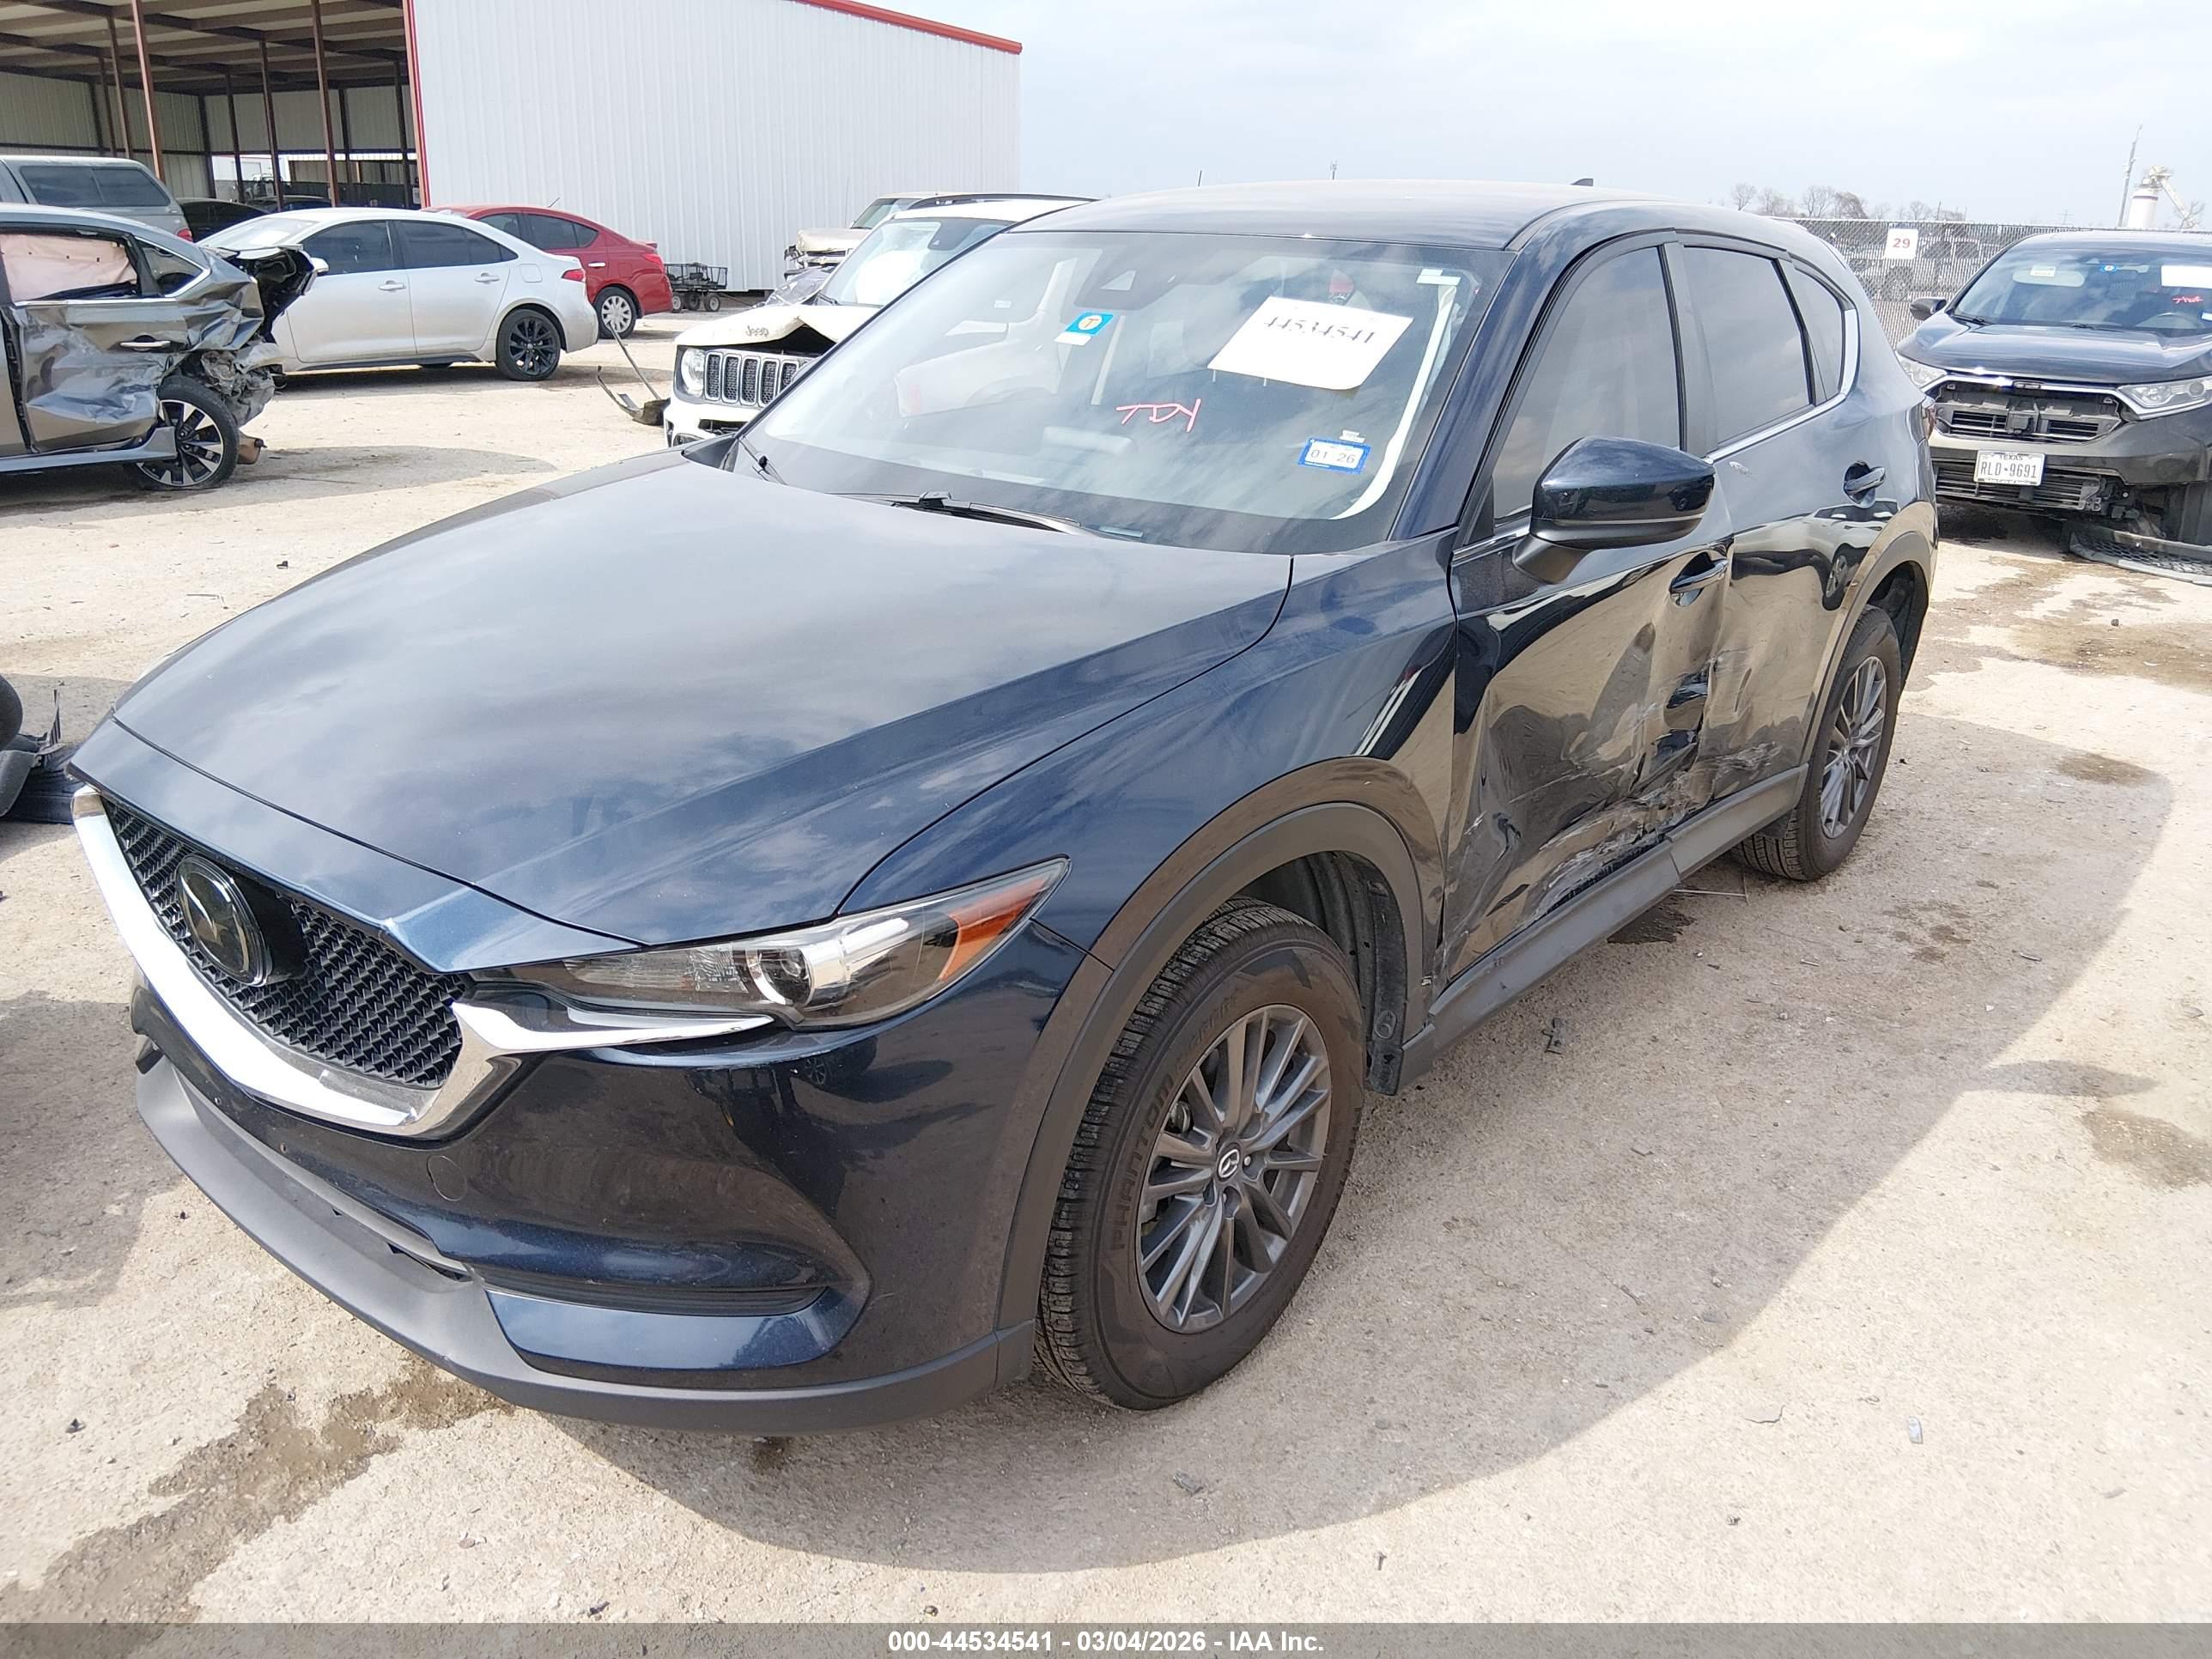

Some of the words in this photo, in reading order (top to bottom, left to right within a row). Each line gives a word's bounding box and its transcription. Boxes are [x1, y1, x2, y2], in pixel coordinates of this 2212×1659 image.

[1892, 238, 1911, 249] 29
[1310, 449, 1328, 459] 01
[1336, 453, 1357, 465] 26
[1999, 453, 2024, 462] TEXAS
